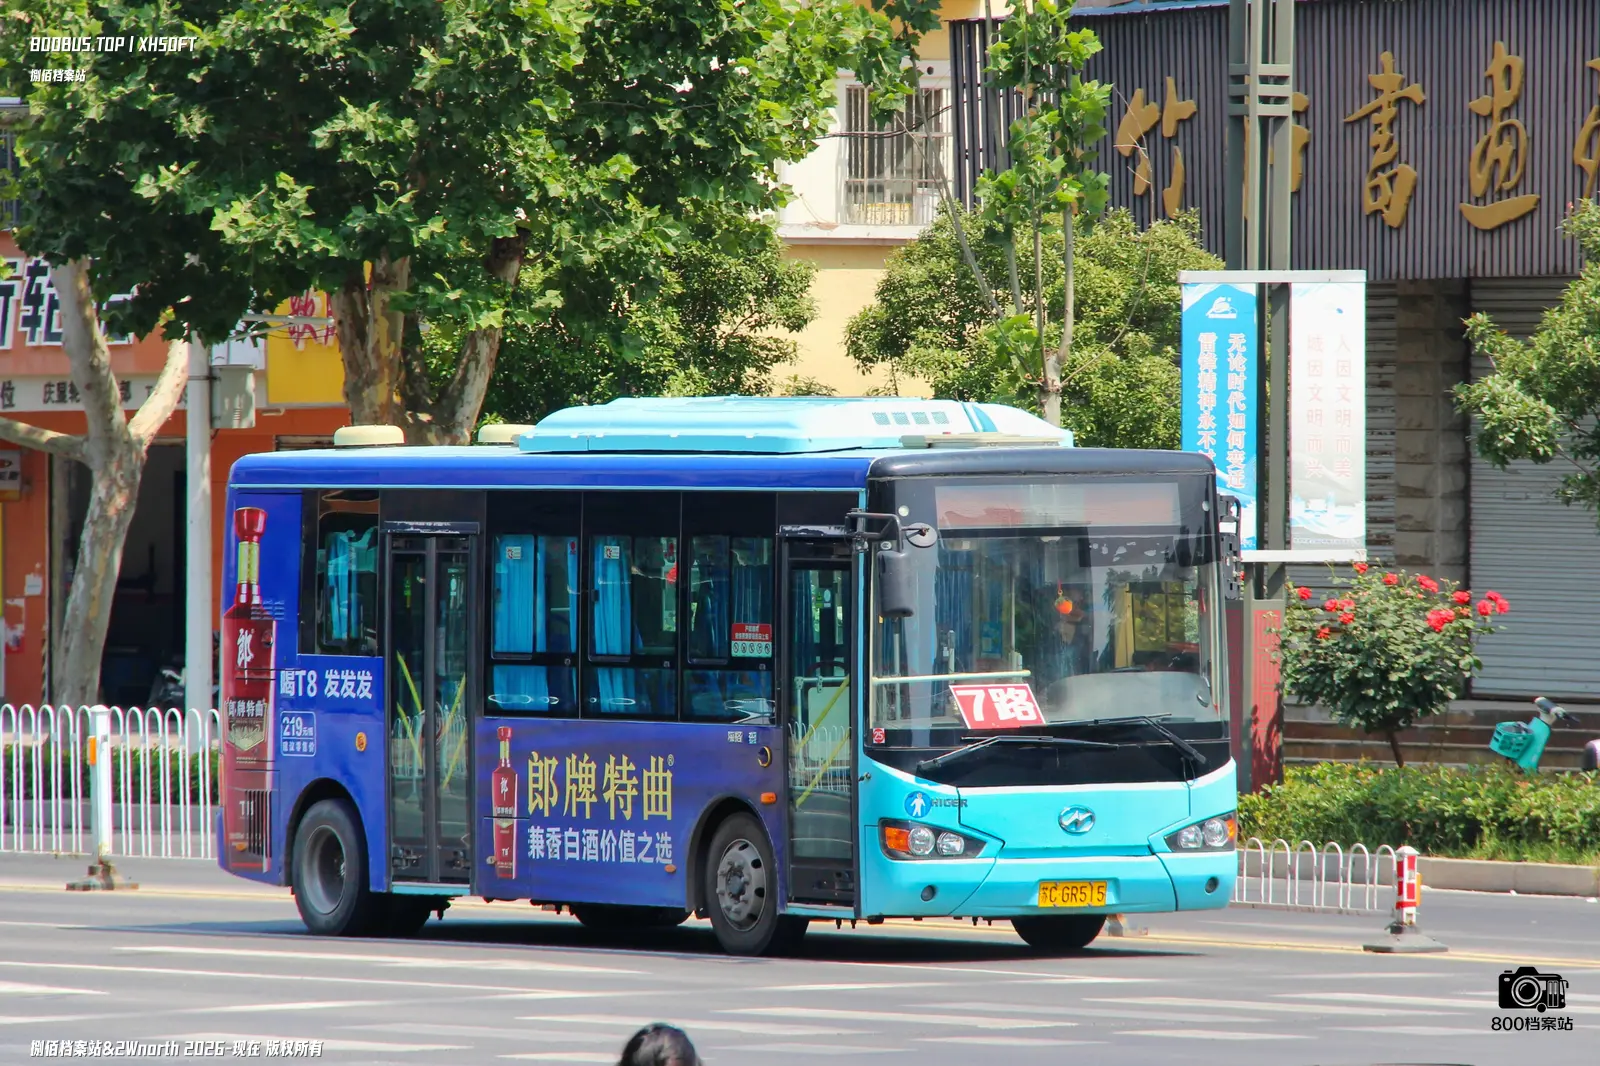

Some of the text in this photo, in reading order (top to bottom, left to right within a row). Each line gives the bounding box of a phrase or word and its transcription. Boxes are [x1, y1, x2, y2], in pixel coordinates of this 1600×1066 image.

[1227, 333, 1247, 489] 无论时代如何变迁
[1335, 334, 1353, 478] 人因文明而美
[280, 669, 373, 699] 喝T8 发发发
[956, 688, 1037, 722] 7路
[931, 798, 968, 808] HIGER
[528, 826, 673, 864] 兼香白酒价值之选
